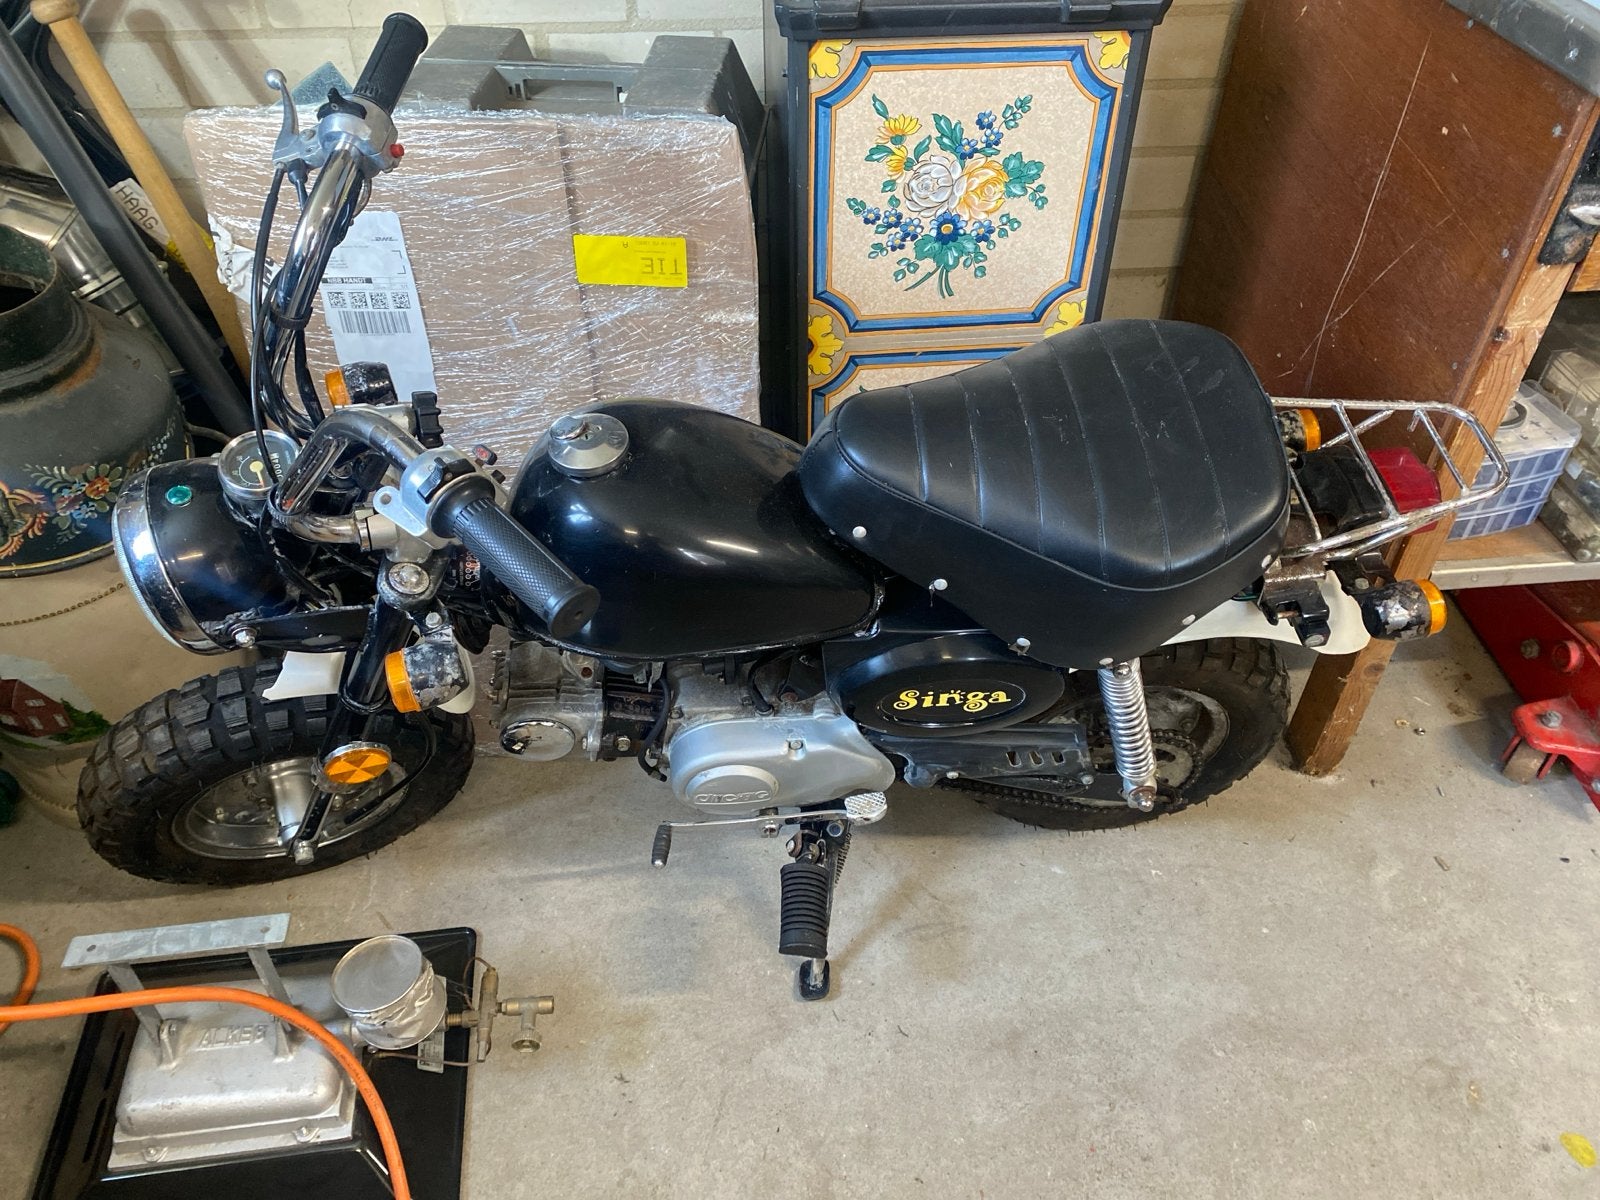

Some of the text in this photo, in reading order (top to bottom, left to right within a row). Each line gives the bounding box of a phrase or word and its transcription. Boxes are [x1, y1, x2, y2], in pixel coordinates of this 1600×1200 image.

[116, 185, 159, 230] HAAG
[641, 258, 682, 275] TIE
[893, 689, 1011, 712] Singa
